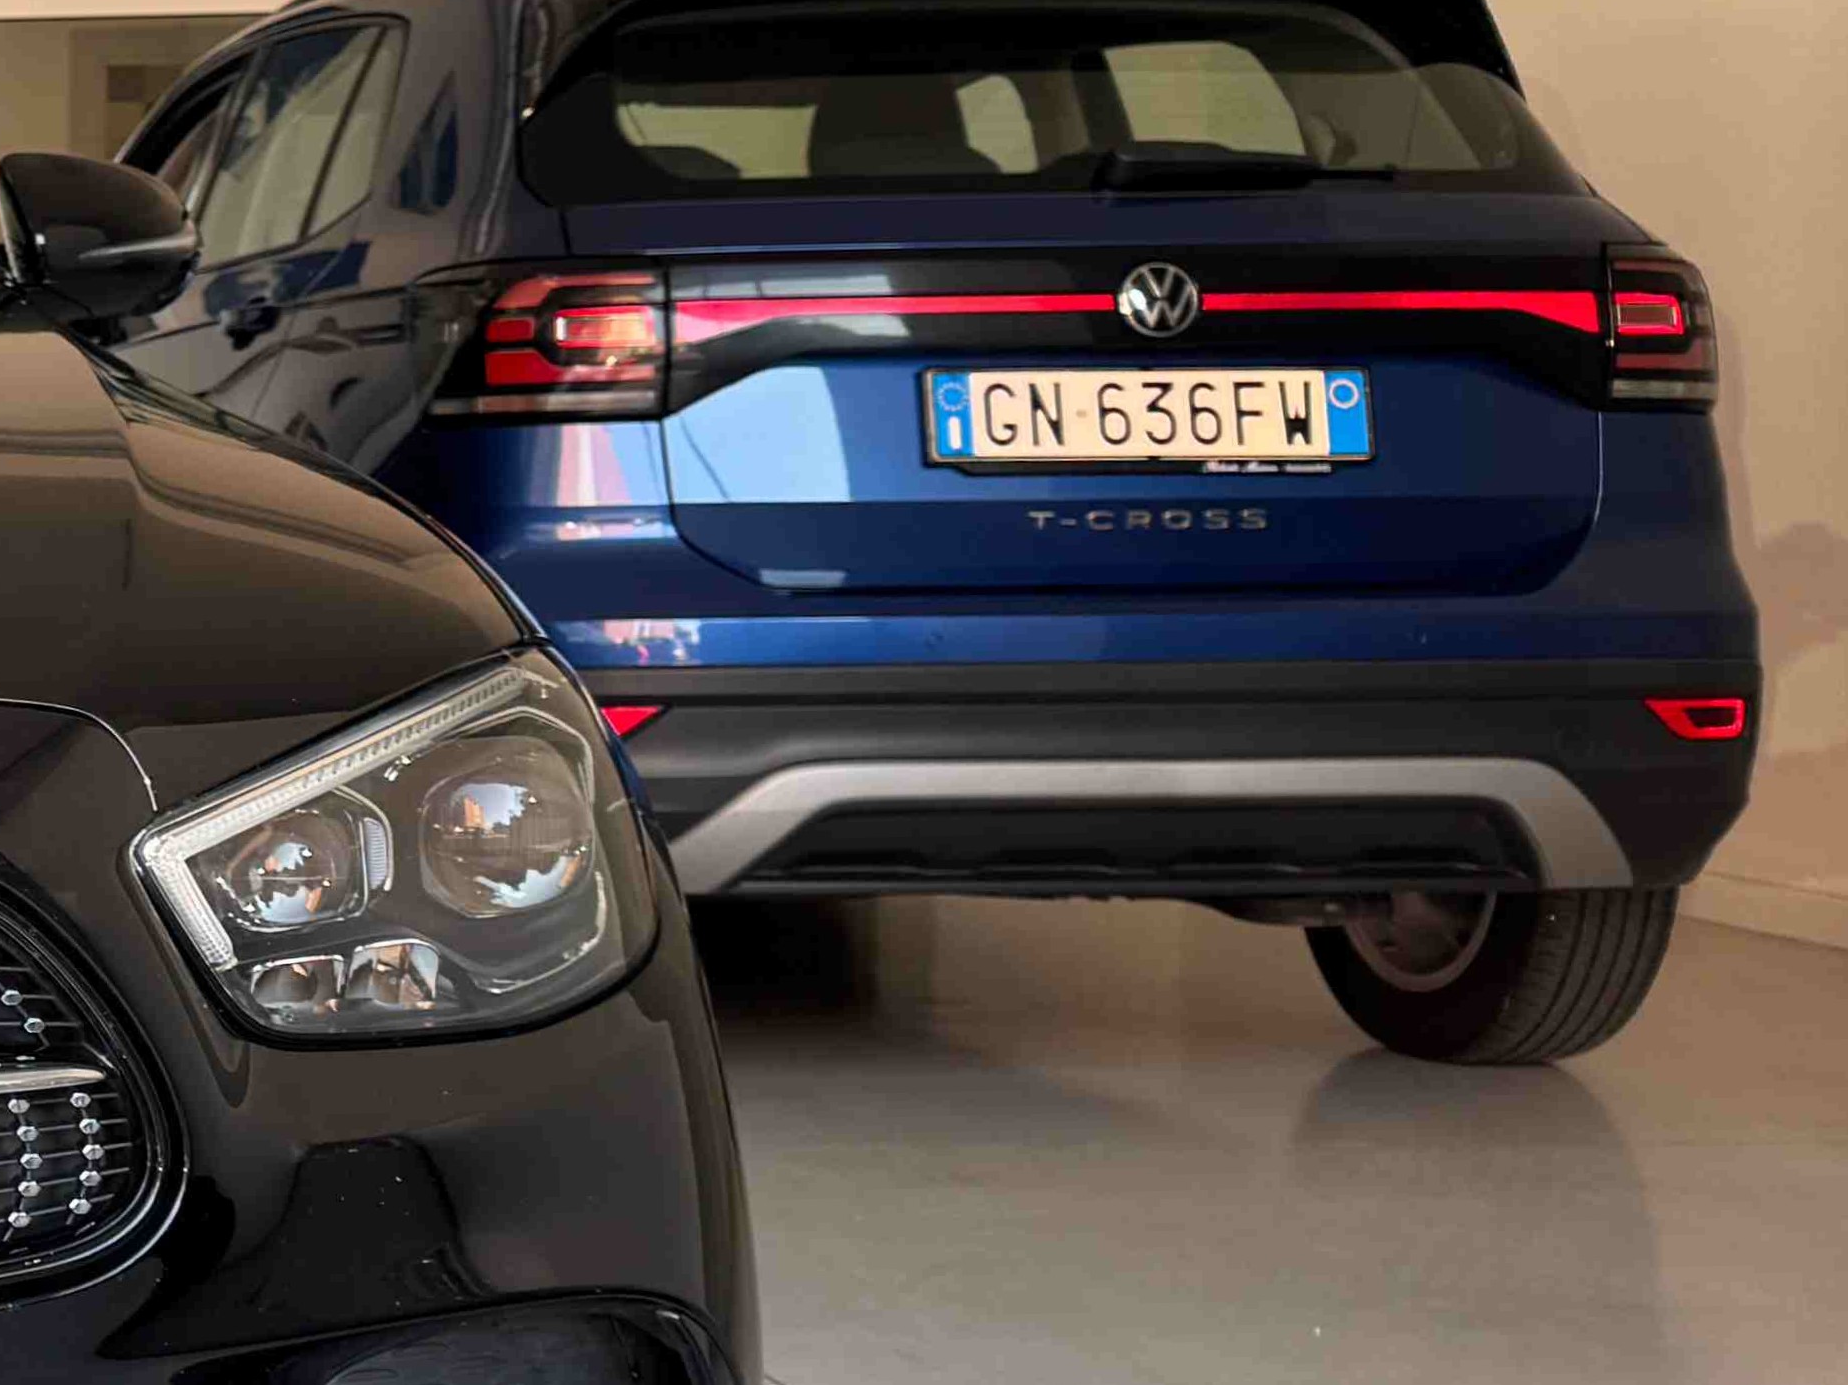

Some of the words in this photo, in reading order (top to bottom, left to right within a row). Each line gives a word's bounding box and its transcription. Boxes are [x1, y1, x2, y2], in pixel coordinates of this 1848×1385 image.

[983, 382, 1065, 447] GN
[1097, 381, 1313, 446] 636FW
[1028, 509, 1268, 531] T-CROSS
